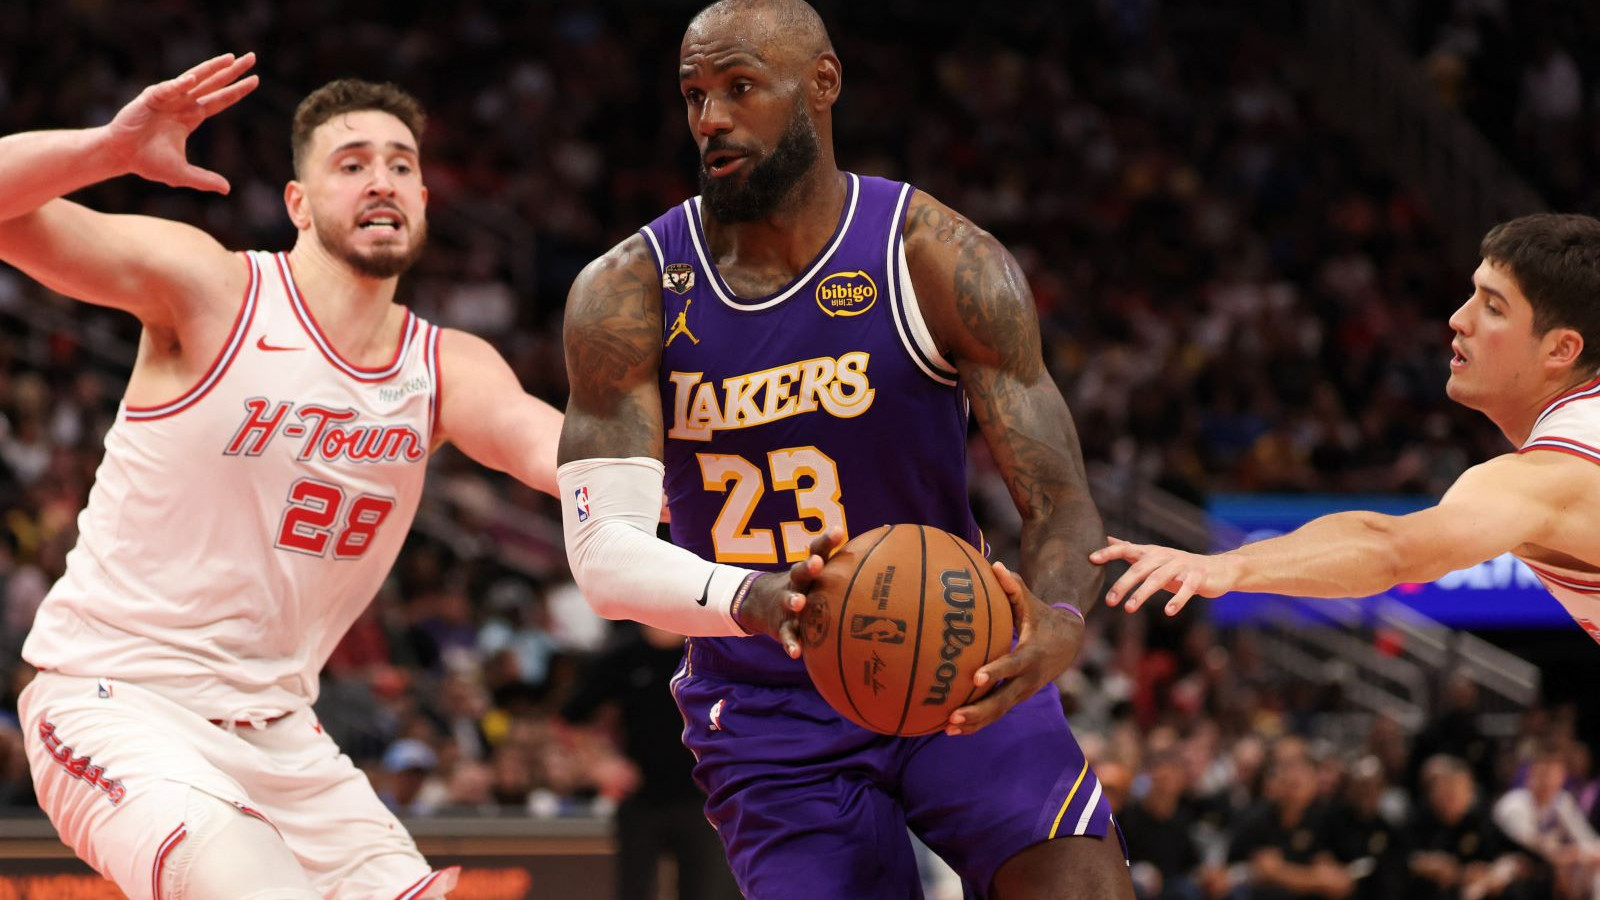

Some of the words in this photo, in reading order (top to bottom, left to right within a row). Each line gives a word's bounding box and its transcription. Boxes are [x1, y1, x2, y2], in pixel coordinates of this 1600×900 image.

[822, 283, 873, 302] bibigo
[831, 298, 853, 307] 비비고
[223, 397, 426, 463] H-Town
[274, 477, 396, 561] 28
[695, 446, 849, 564] 23
[921, 568, 977, 707] Wilson
